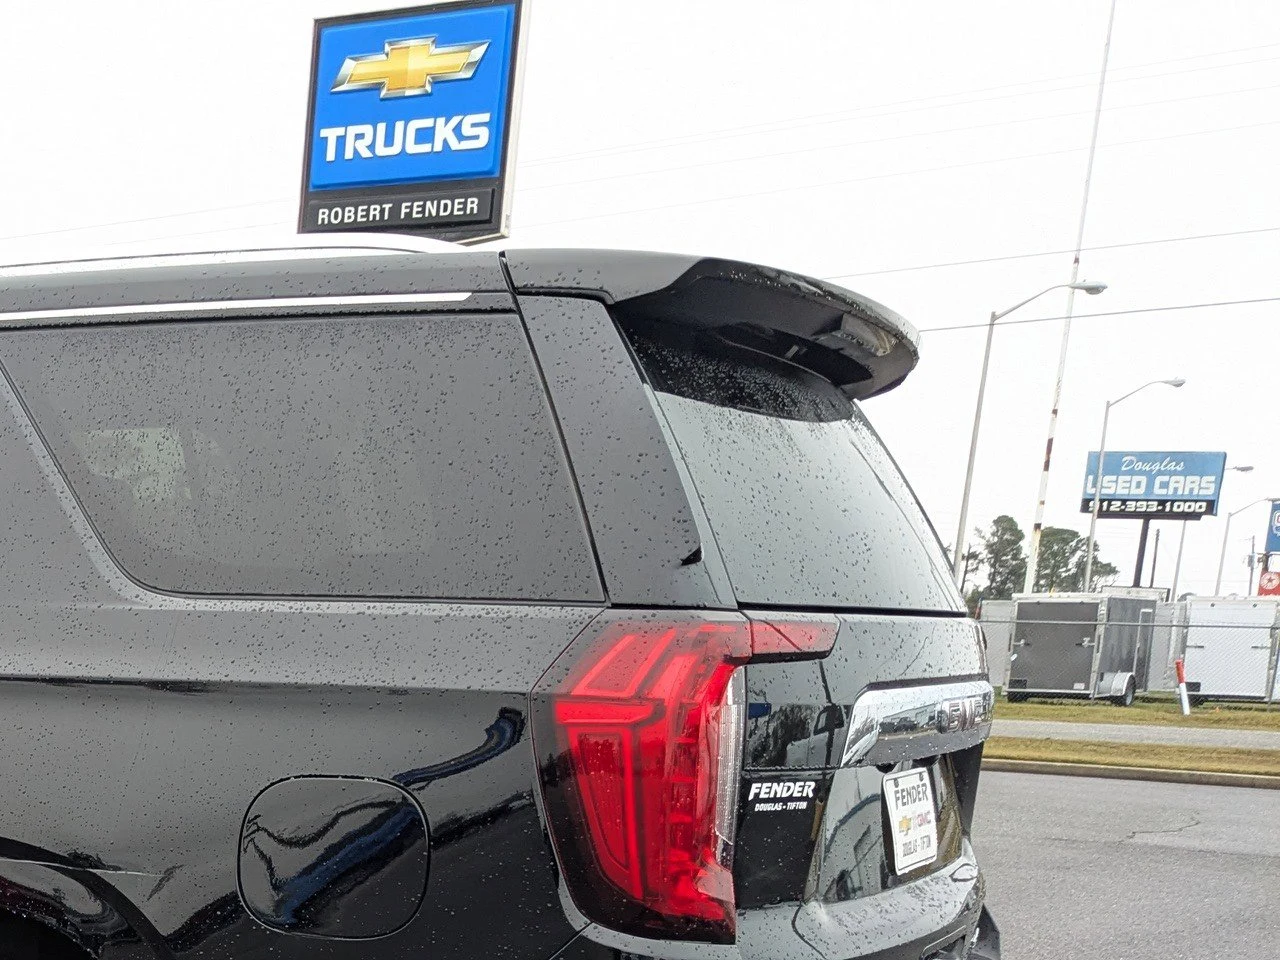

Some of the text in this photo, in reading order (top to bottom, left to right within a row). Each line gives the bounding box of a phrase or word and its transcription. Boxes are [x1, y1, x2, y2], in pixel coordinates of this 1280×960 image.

[320, 112, 491, 162] TRUCKS
[317, 198, 479, 225] ROBERT FENDER
[1121, 455, 1185, 474] Douglas
[1153, 475, 1216, 495] CARS
[748, 781, 816, 801] FENDER
[893, 782, 929, 810] FENDER
[754, 802, 783, 812] DOUGLAS
